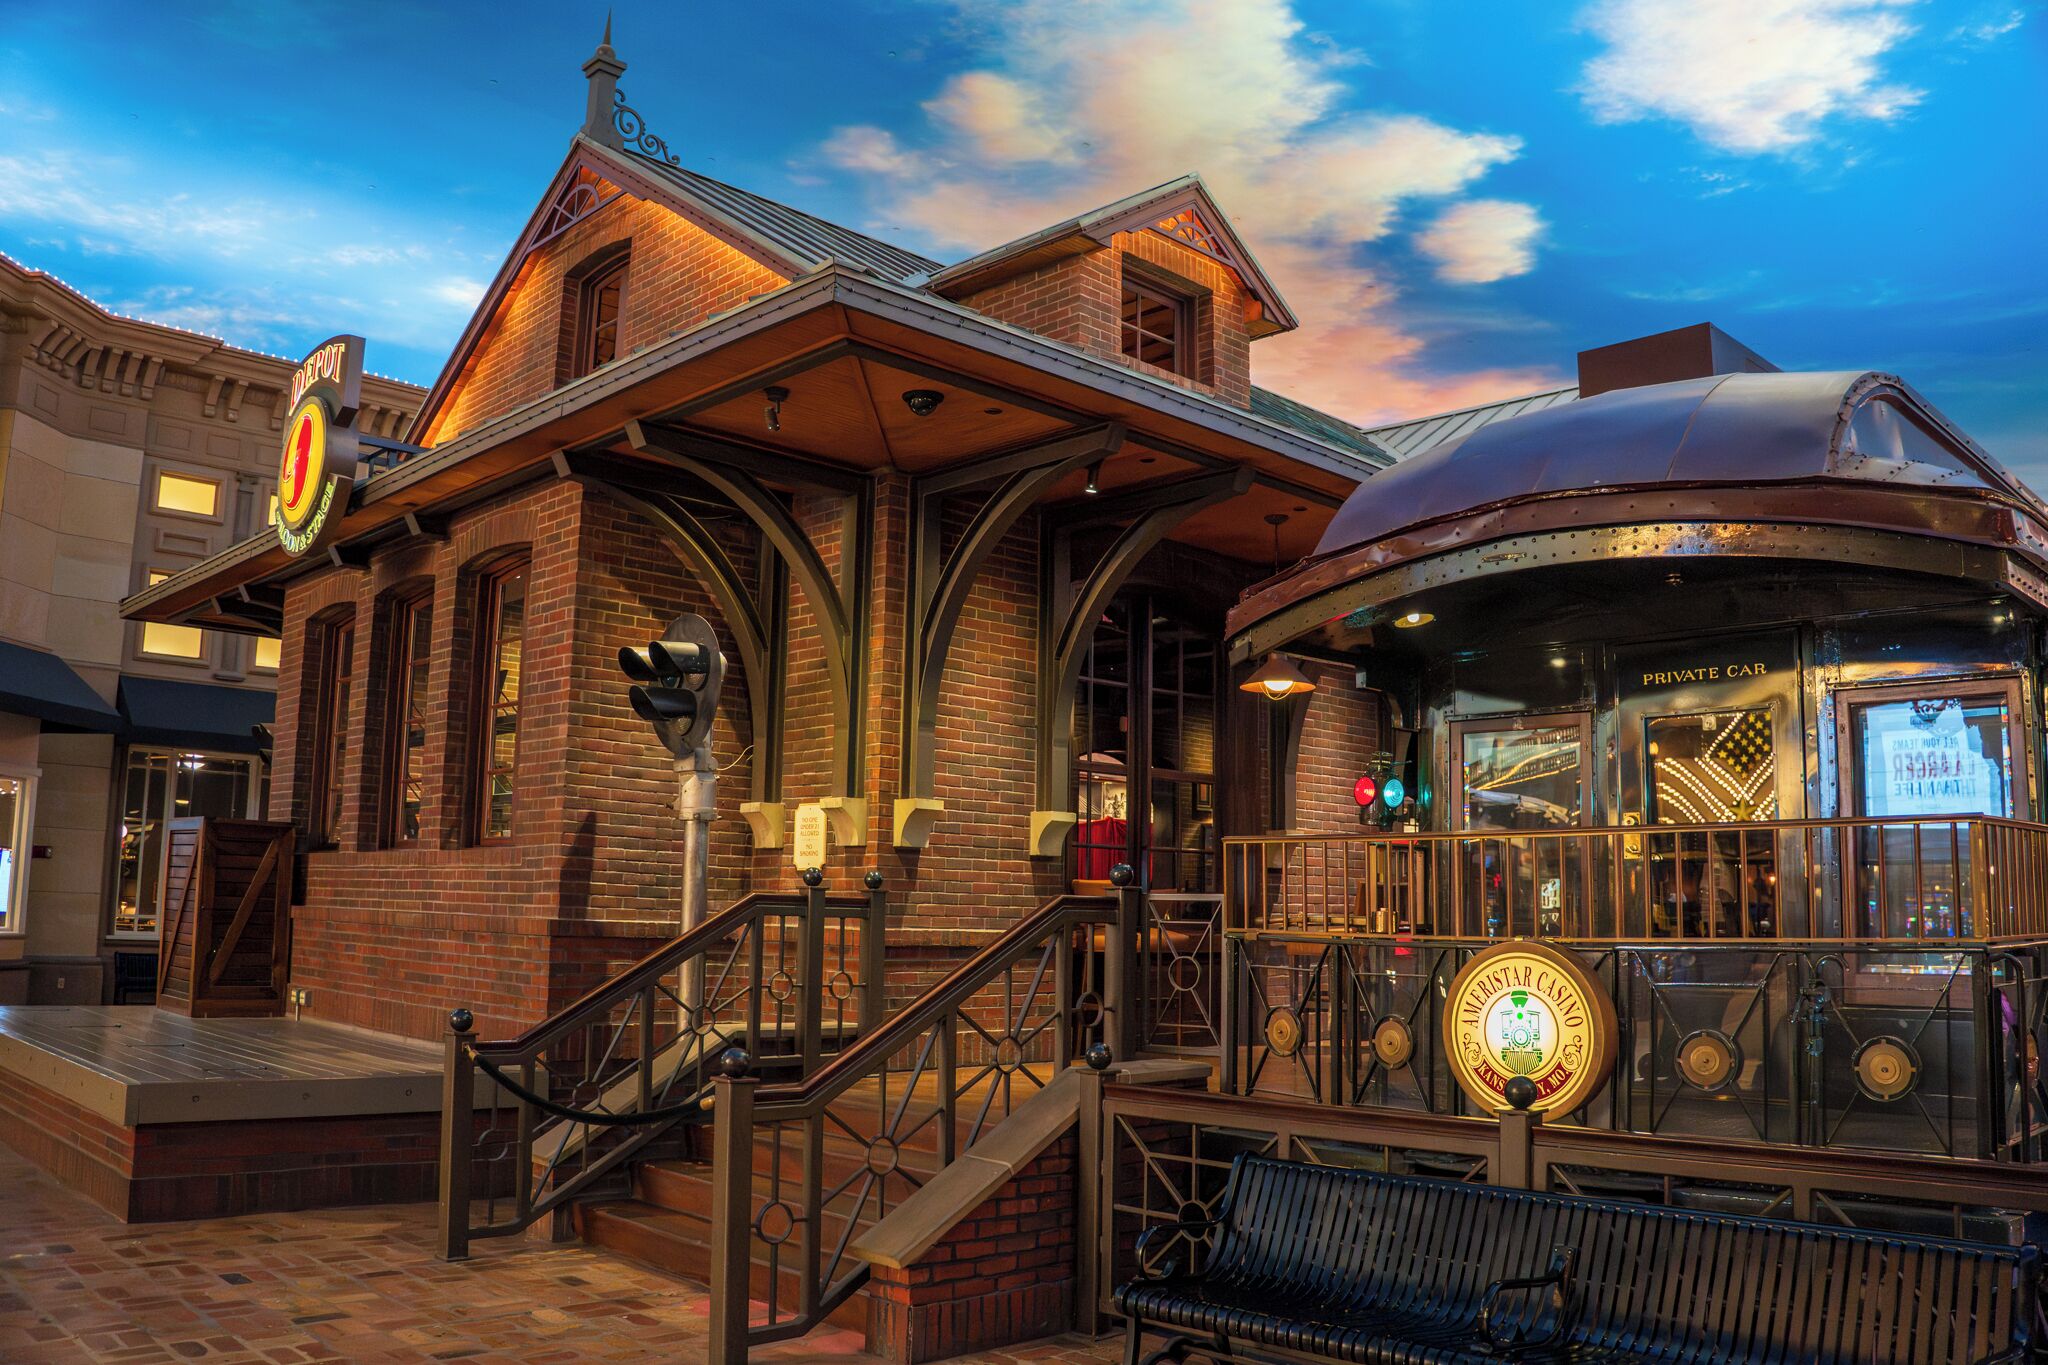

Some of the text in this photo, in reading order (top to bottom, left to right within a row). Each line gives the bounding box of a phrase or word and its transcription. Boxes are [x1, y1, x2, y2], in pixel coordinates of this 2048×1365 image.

[288, 342, 345, 417] DEPOT
[305, 481, 336, 544] STAGE
[1643, 662, 1767, 686] PRIVATE CAR
[1461, 964, 1585, 1030] AMERISTAR CASINO
[1477, 1064, 1505, 1092] KANS
[1551, 1067, 1570, 1088] MO.
